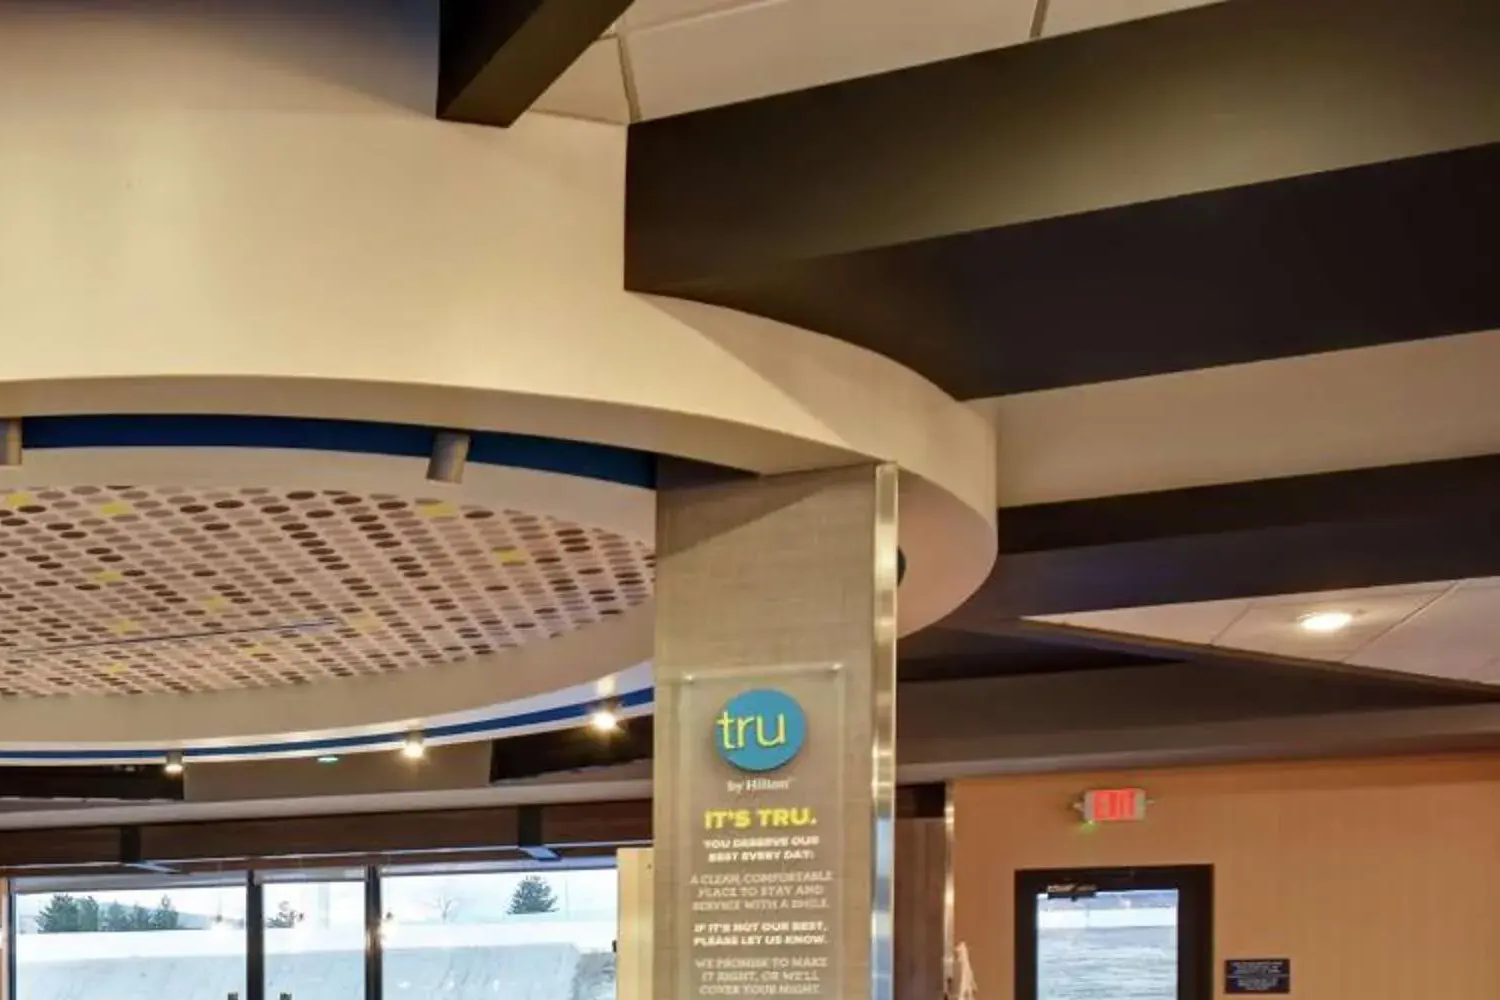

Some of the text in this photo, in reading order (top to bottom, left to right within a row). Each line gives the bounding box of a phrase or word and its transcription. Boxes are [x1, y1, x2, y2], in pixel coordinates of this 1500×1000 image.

[716, 710, 787, 750] tru
[726, 780, 742, 795] by
[704, 806, 818, 829] IT'S TRU.
[702, 838, 731, 849] YOU
[791, 835, 819, 847] OUR
[708, 851, 739, 862] BEST
[741, 850, 781, 861] EVERY
[795, 884, 824, 896] AND
[733, 922, 760, 932] NOT
[761, 921, 789, 931] OUR
[693, 935, 739, 946] PLEASE
[741, 934, 762, 945] LET
[764, 934, 782, 945] US
